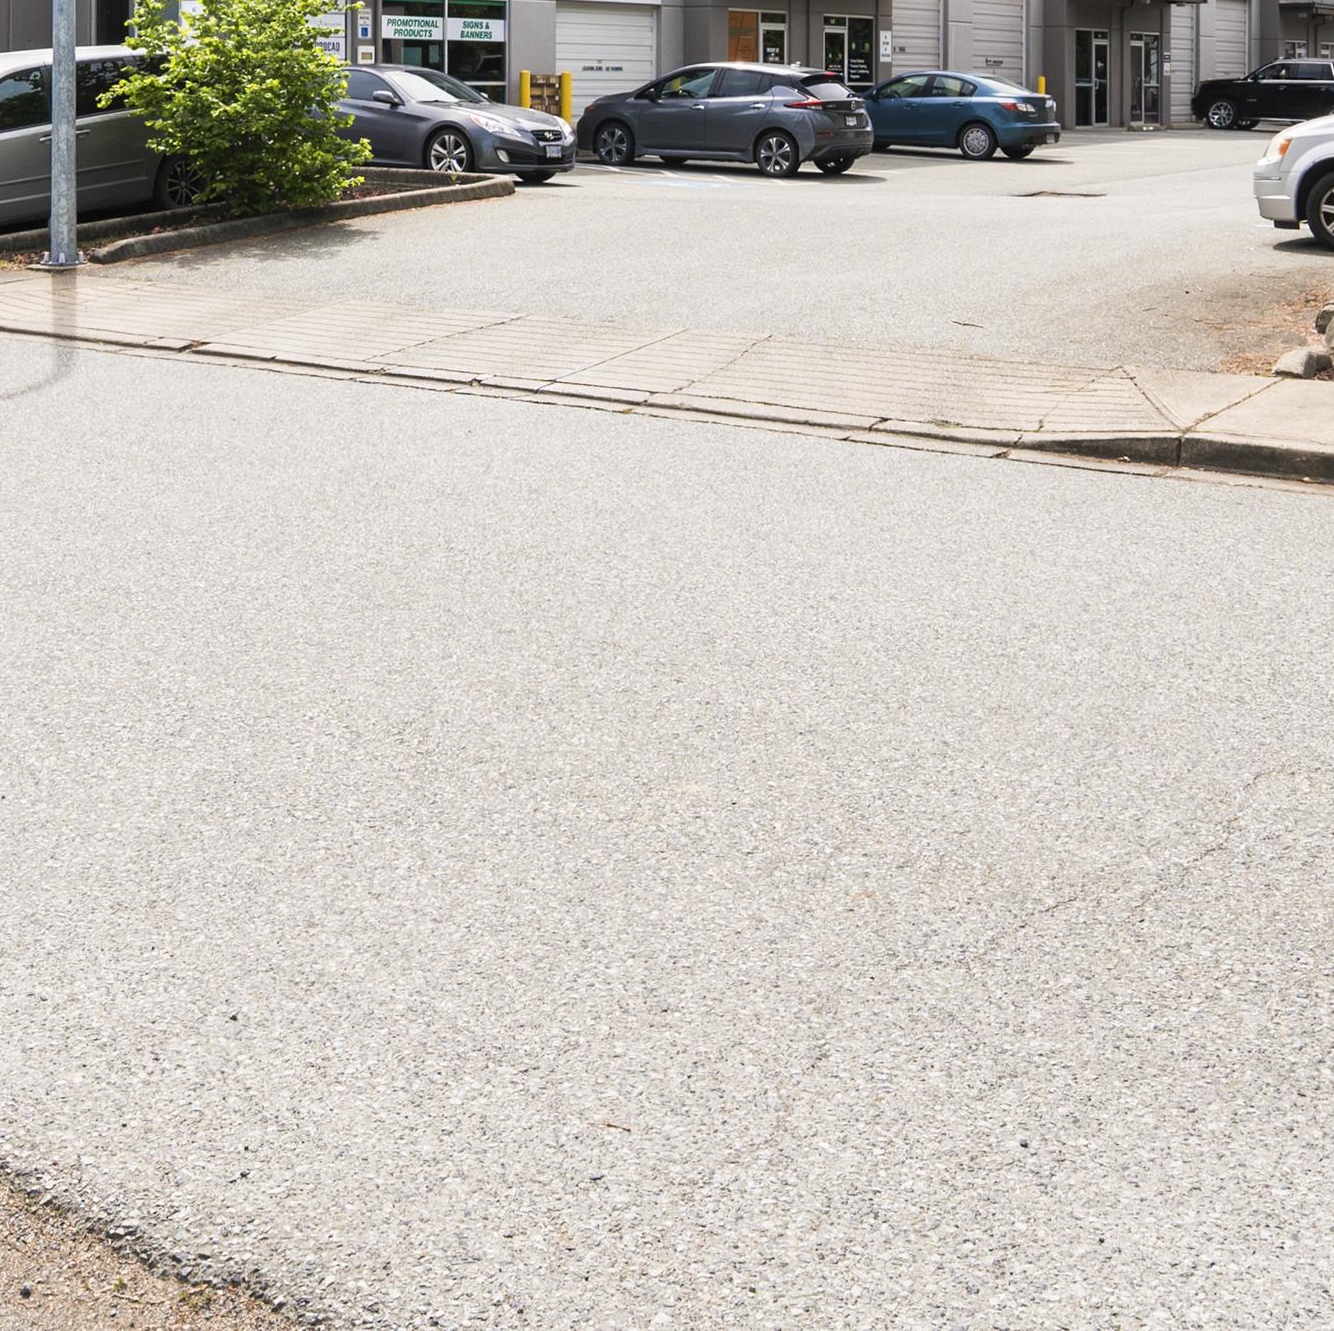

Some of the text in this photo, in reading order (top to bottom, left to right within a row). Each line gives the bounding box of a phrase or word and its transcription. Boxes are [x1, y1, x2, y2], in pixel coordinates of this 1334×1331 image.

[387, 18, 439, 28] PROMOTIONAL
[462, 20, 483, 30] SIGNS
[394, 29, 433, 38] PRODUCTS
[460, 30, 493, 39] BANNERS
